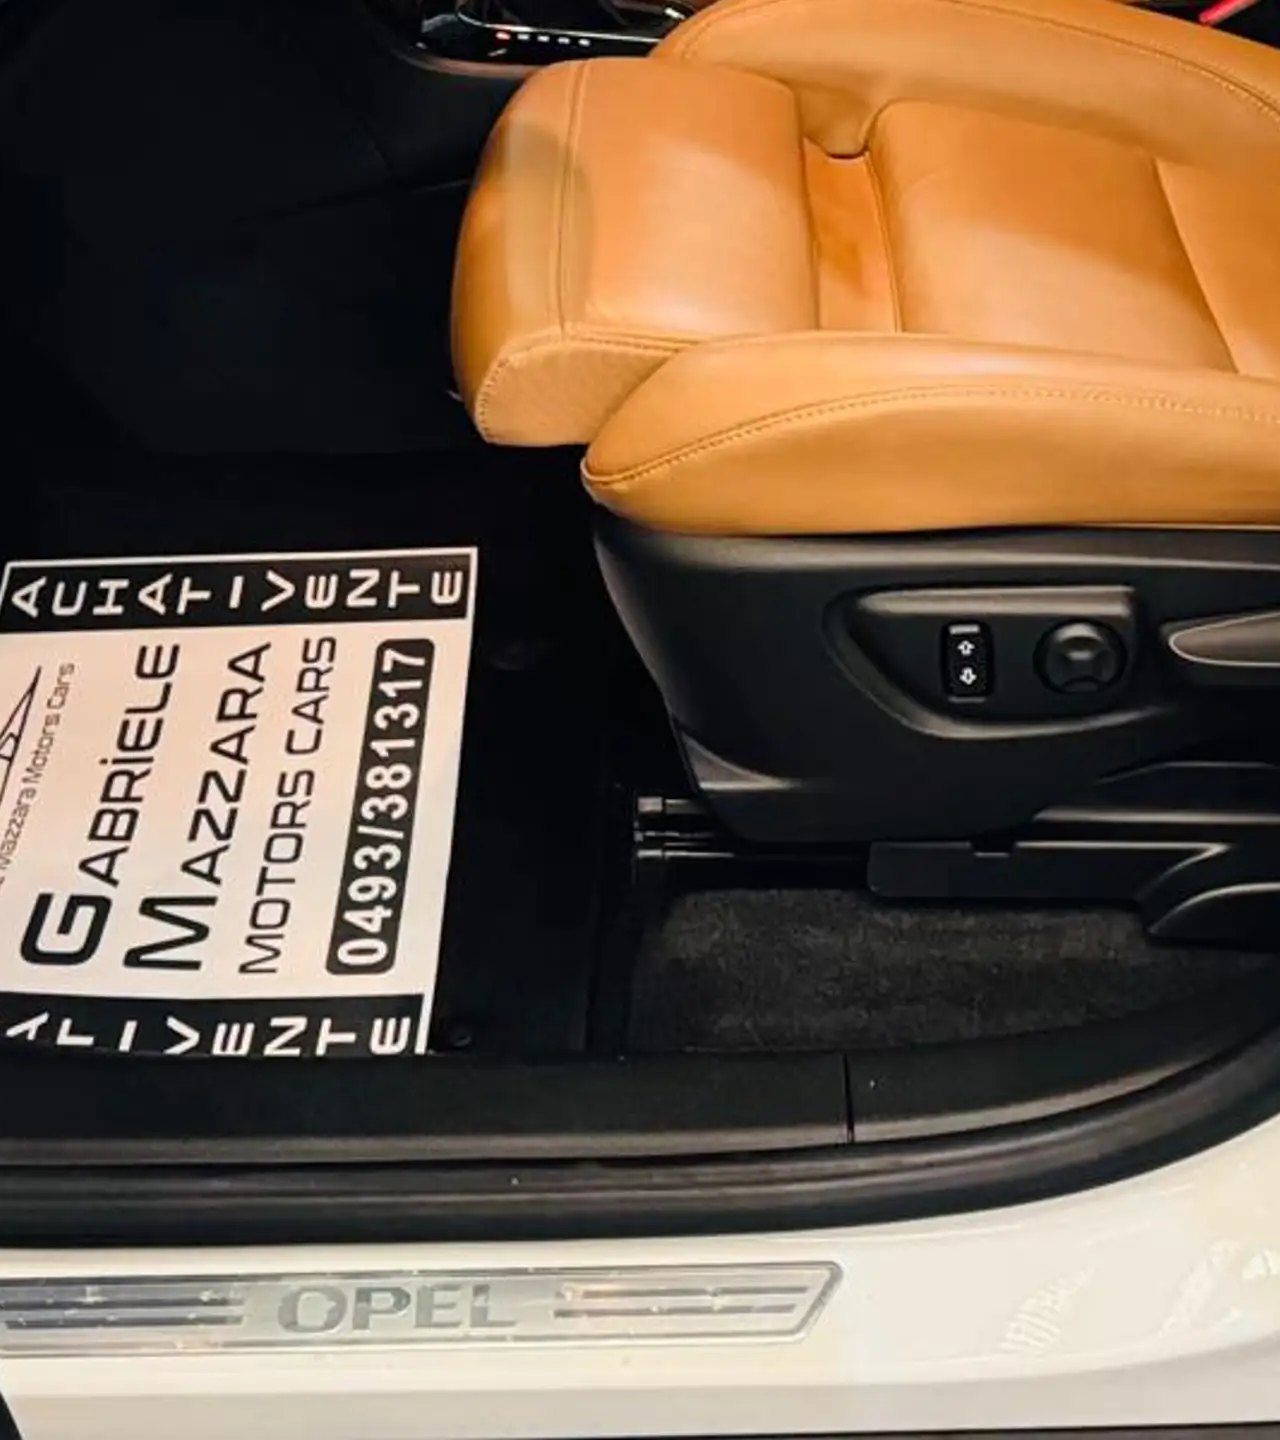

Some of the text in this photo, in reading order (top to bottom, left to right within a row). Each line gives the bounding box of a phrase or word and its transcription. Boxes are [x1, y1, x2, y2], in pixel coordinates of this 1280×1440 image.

[22, 710, 61, 786] Motors
[46, 662, 76, 709] Cars
[122, 641, 272, 970] MAZZARA
[238, 636, 337, 974] MOTORS CARS
[336, 646, 426, 966] 0493/381317
[277, 1284, 517, 1333] OPEL
